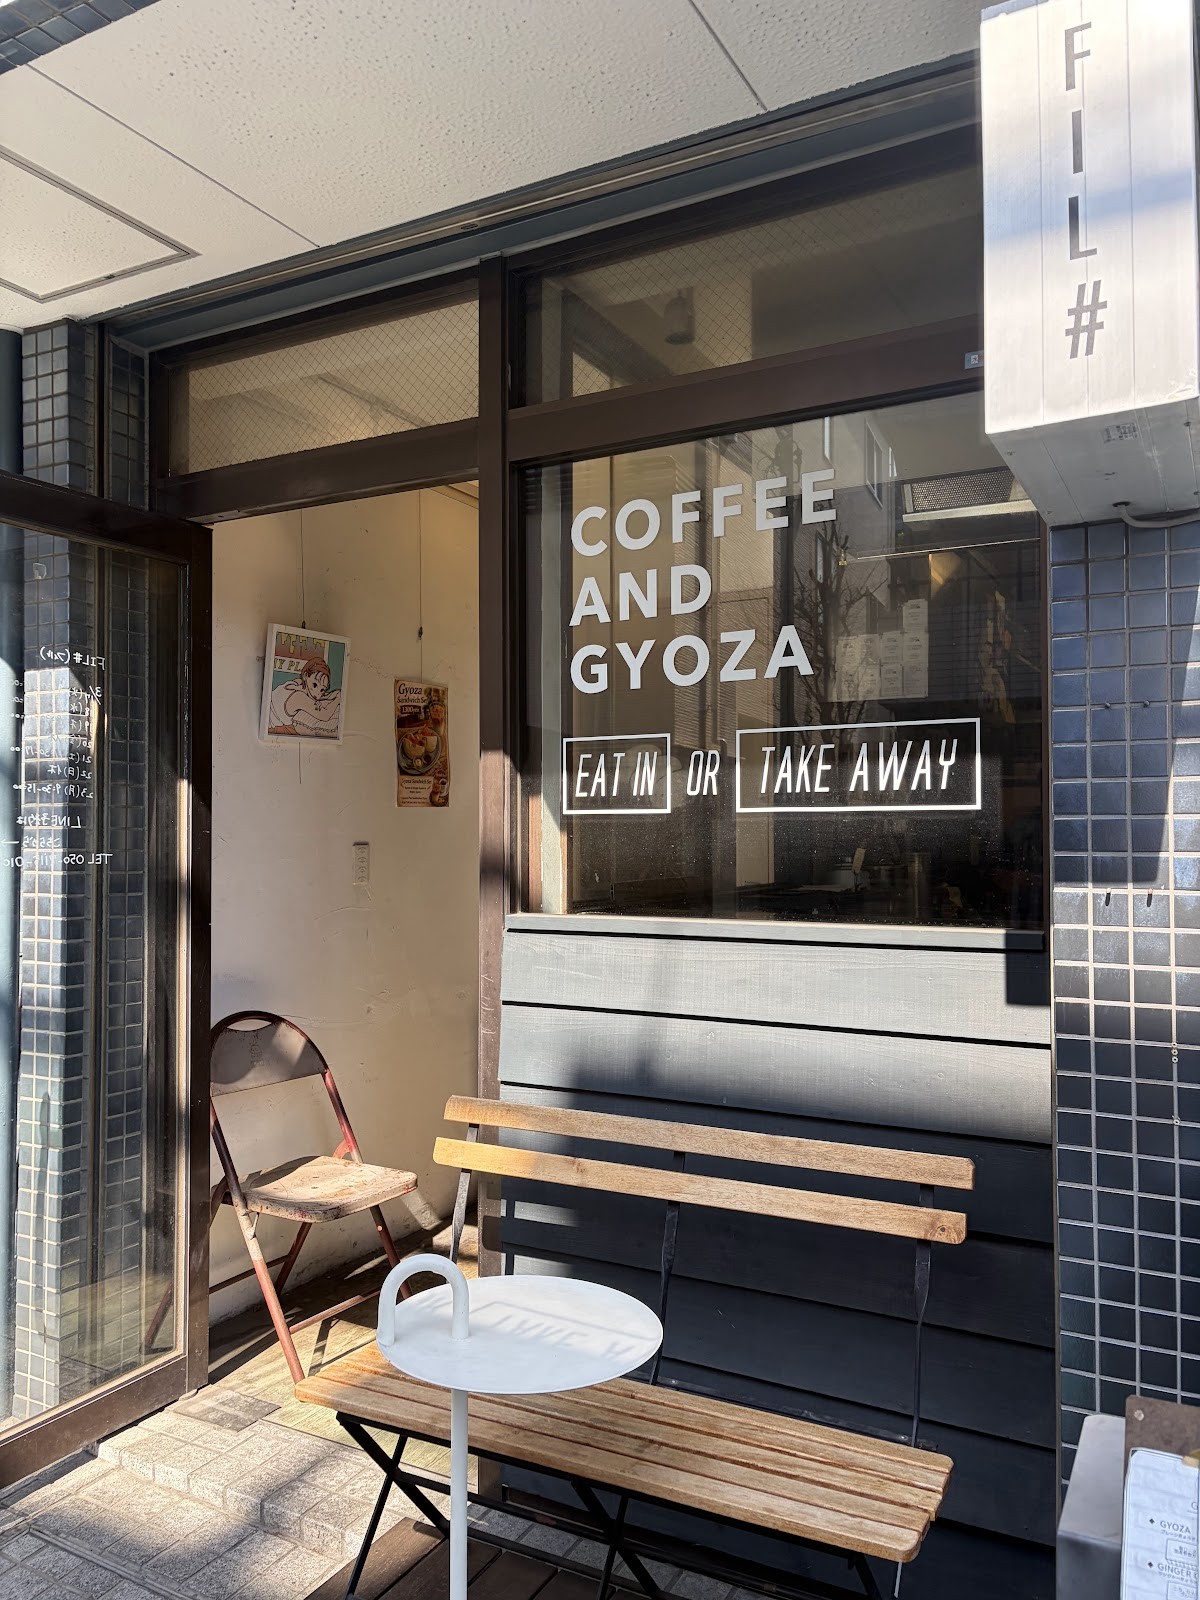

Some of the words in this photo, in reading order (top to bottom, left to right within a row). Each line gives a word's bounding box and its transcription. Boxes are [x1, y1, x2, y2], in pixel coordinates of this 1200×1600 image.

[570, 468, 837, 557] COFFEE
[569, 563, 712, 627] AND
[570, 624, 814, 694] GYOZA
[398, 683, 423, 697] Gyoza
[575, 752, 625, 797] EAT
[633, 751, 658, 796] IN
[687, 750, 721, 796] OR
[760, 743, 836, 795] TAKE
[850, 738, 959, 793] AWAY
[1159, 1519, 1191, 1535] GYOZA
[1157, 1562, 1192, 1578] GINGER
